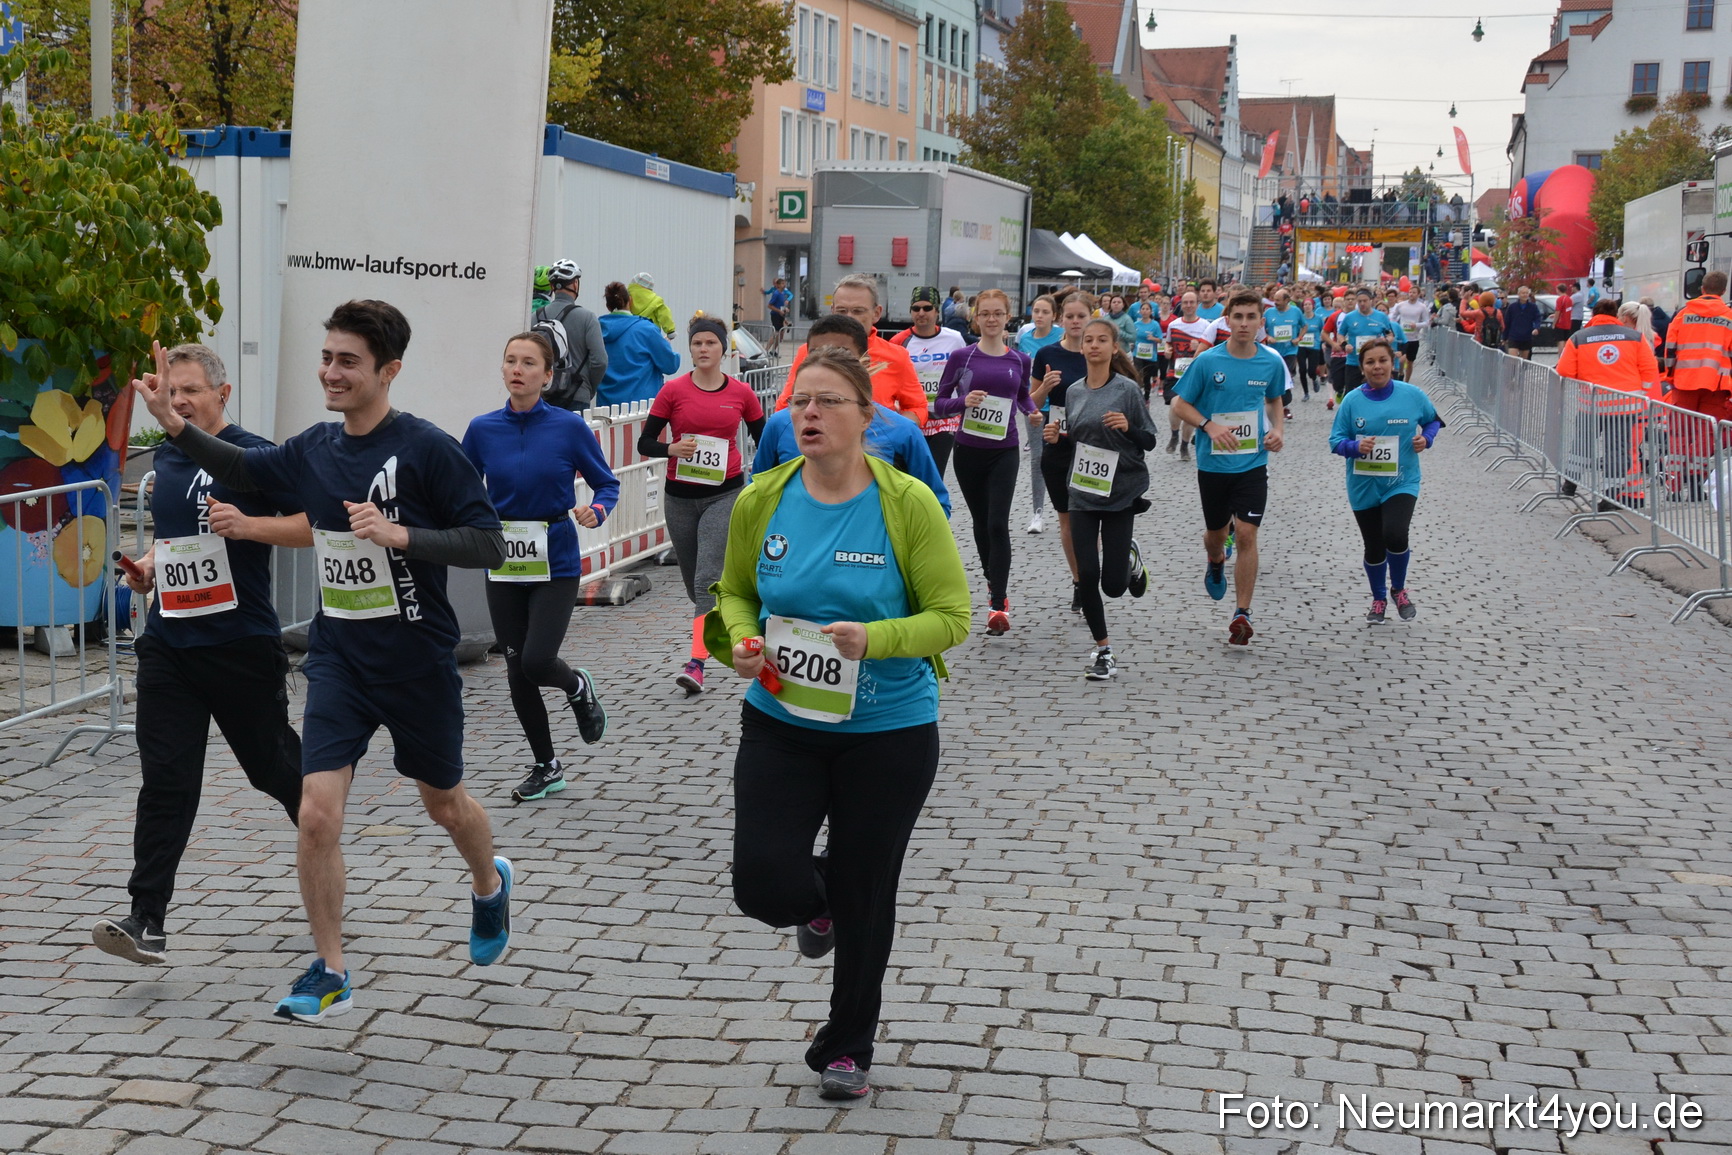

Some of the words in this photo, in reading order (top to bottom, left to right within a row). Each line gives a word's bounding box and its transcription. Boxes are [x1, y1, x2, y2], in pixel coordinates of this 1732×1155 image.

[783, 194, 802, 215] D
[1347, 231, 1375, 240] ZIEL
[287, 251, 487, 280] www.bmw-laufsport.de
[1686, 315, 1731, 327] NOTARZT
[1586, 334, 1626, 343] BEREITSCHAFTEN
[920, 381, 939, 392] 503
[971, 406, 1003, 423] 5078
[922, 427, 939, 436] VIA
[1078, 458, 1109, 477] 5139
[505, 540, 538, 558] 004
[382, 506, 423, 622] RAIL.E
[834, 550, 887, 566] BOCK
[165, 559, 219, 587] 8013
[323, 557, 377, 585] 5248
[759, 563, 783, 573] PARTL
[177, 592, 212, 604] RAIL.ONE
[801, 629, 833, 643] BOCK
[777, 645, 842, 685] 5208
